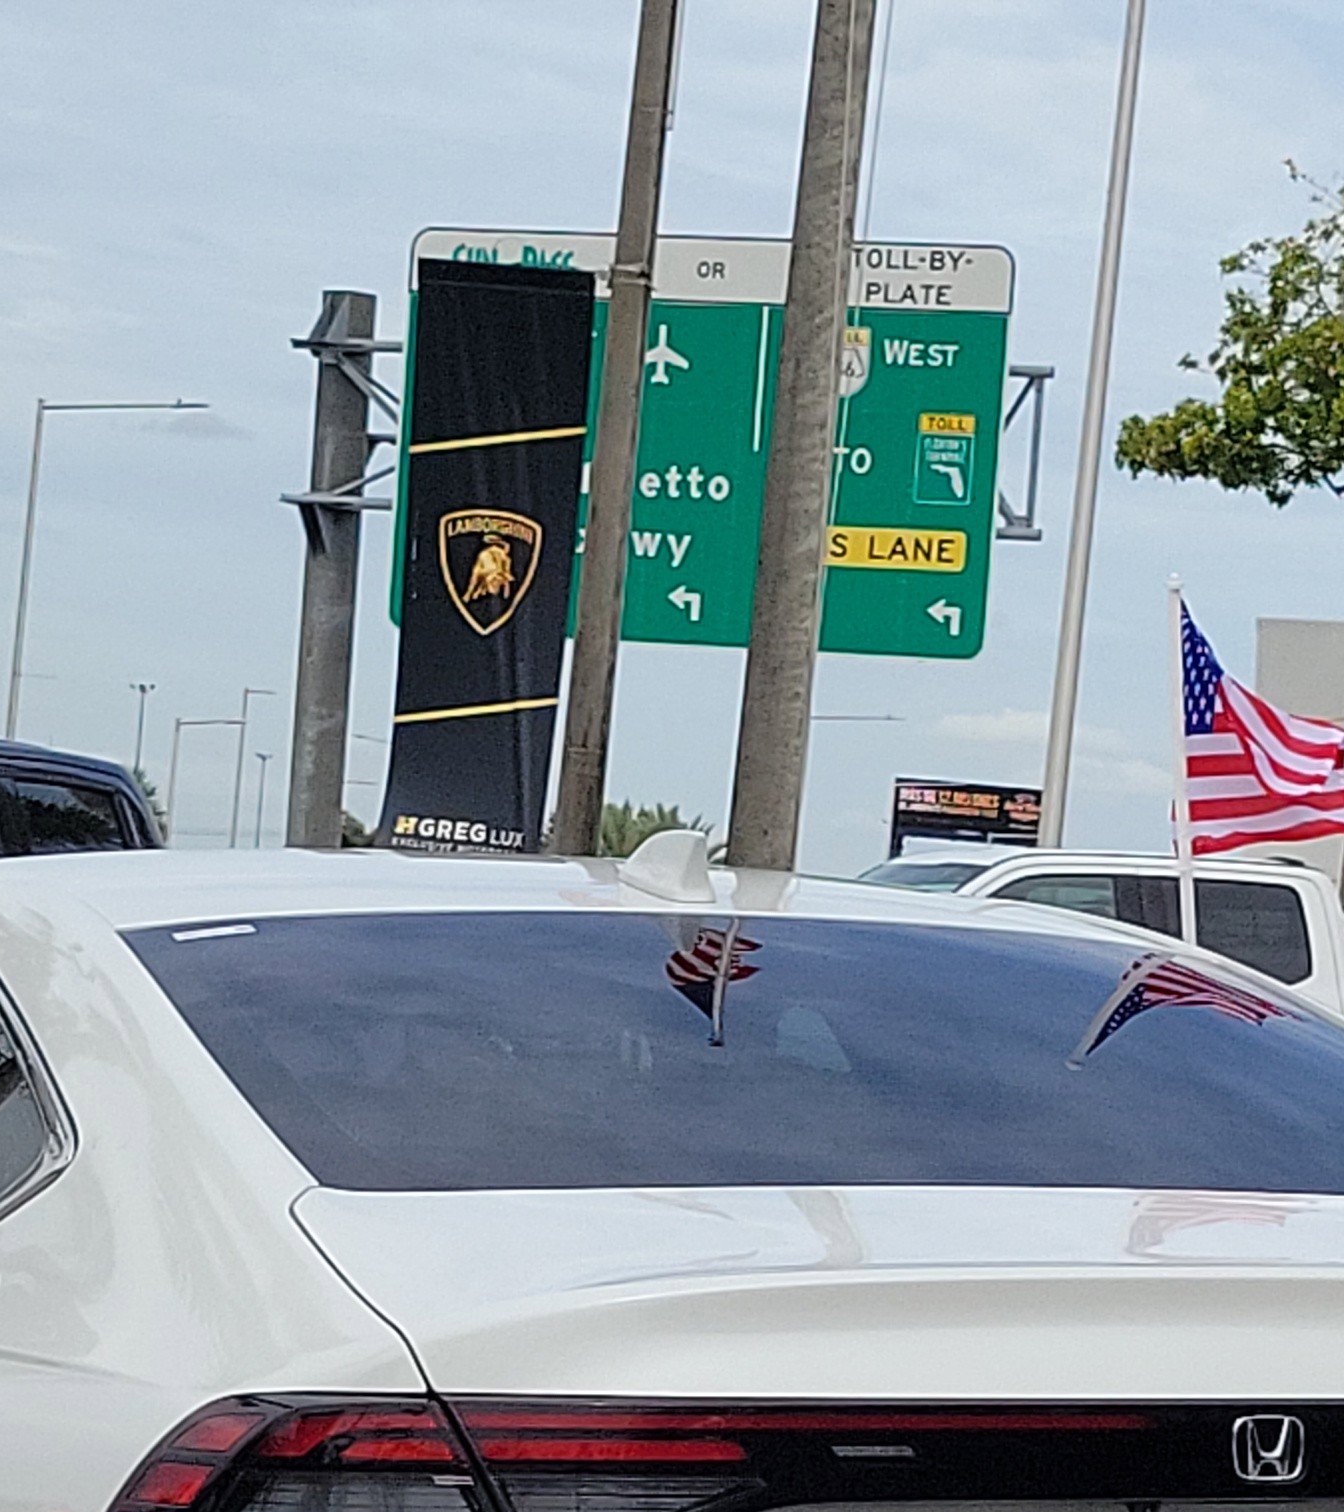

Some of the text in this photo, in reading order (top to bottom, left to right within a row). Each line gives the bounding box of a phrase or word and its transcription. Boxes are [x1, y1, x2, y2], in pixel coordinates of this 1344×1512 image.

[697, 260, 725, 279] OR
[865, 281, 952, 306] PLATE
[883, 337, 959, 367] WEST
[927, 417, 967, 431] TOLL
[868, 534, 956, 564] LANE
[489, 828, 527, 849] LUX
